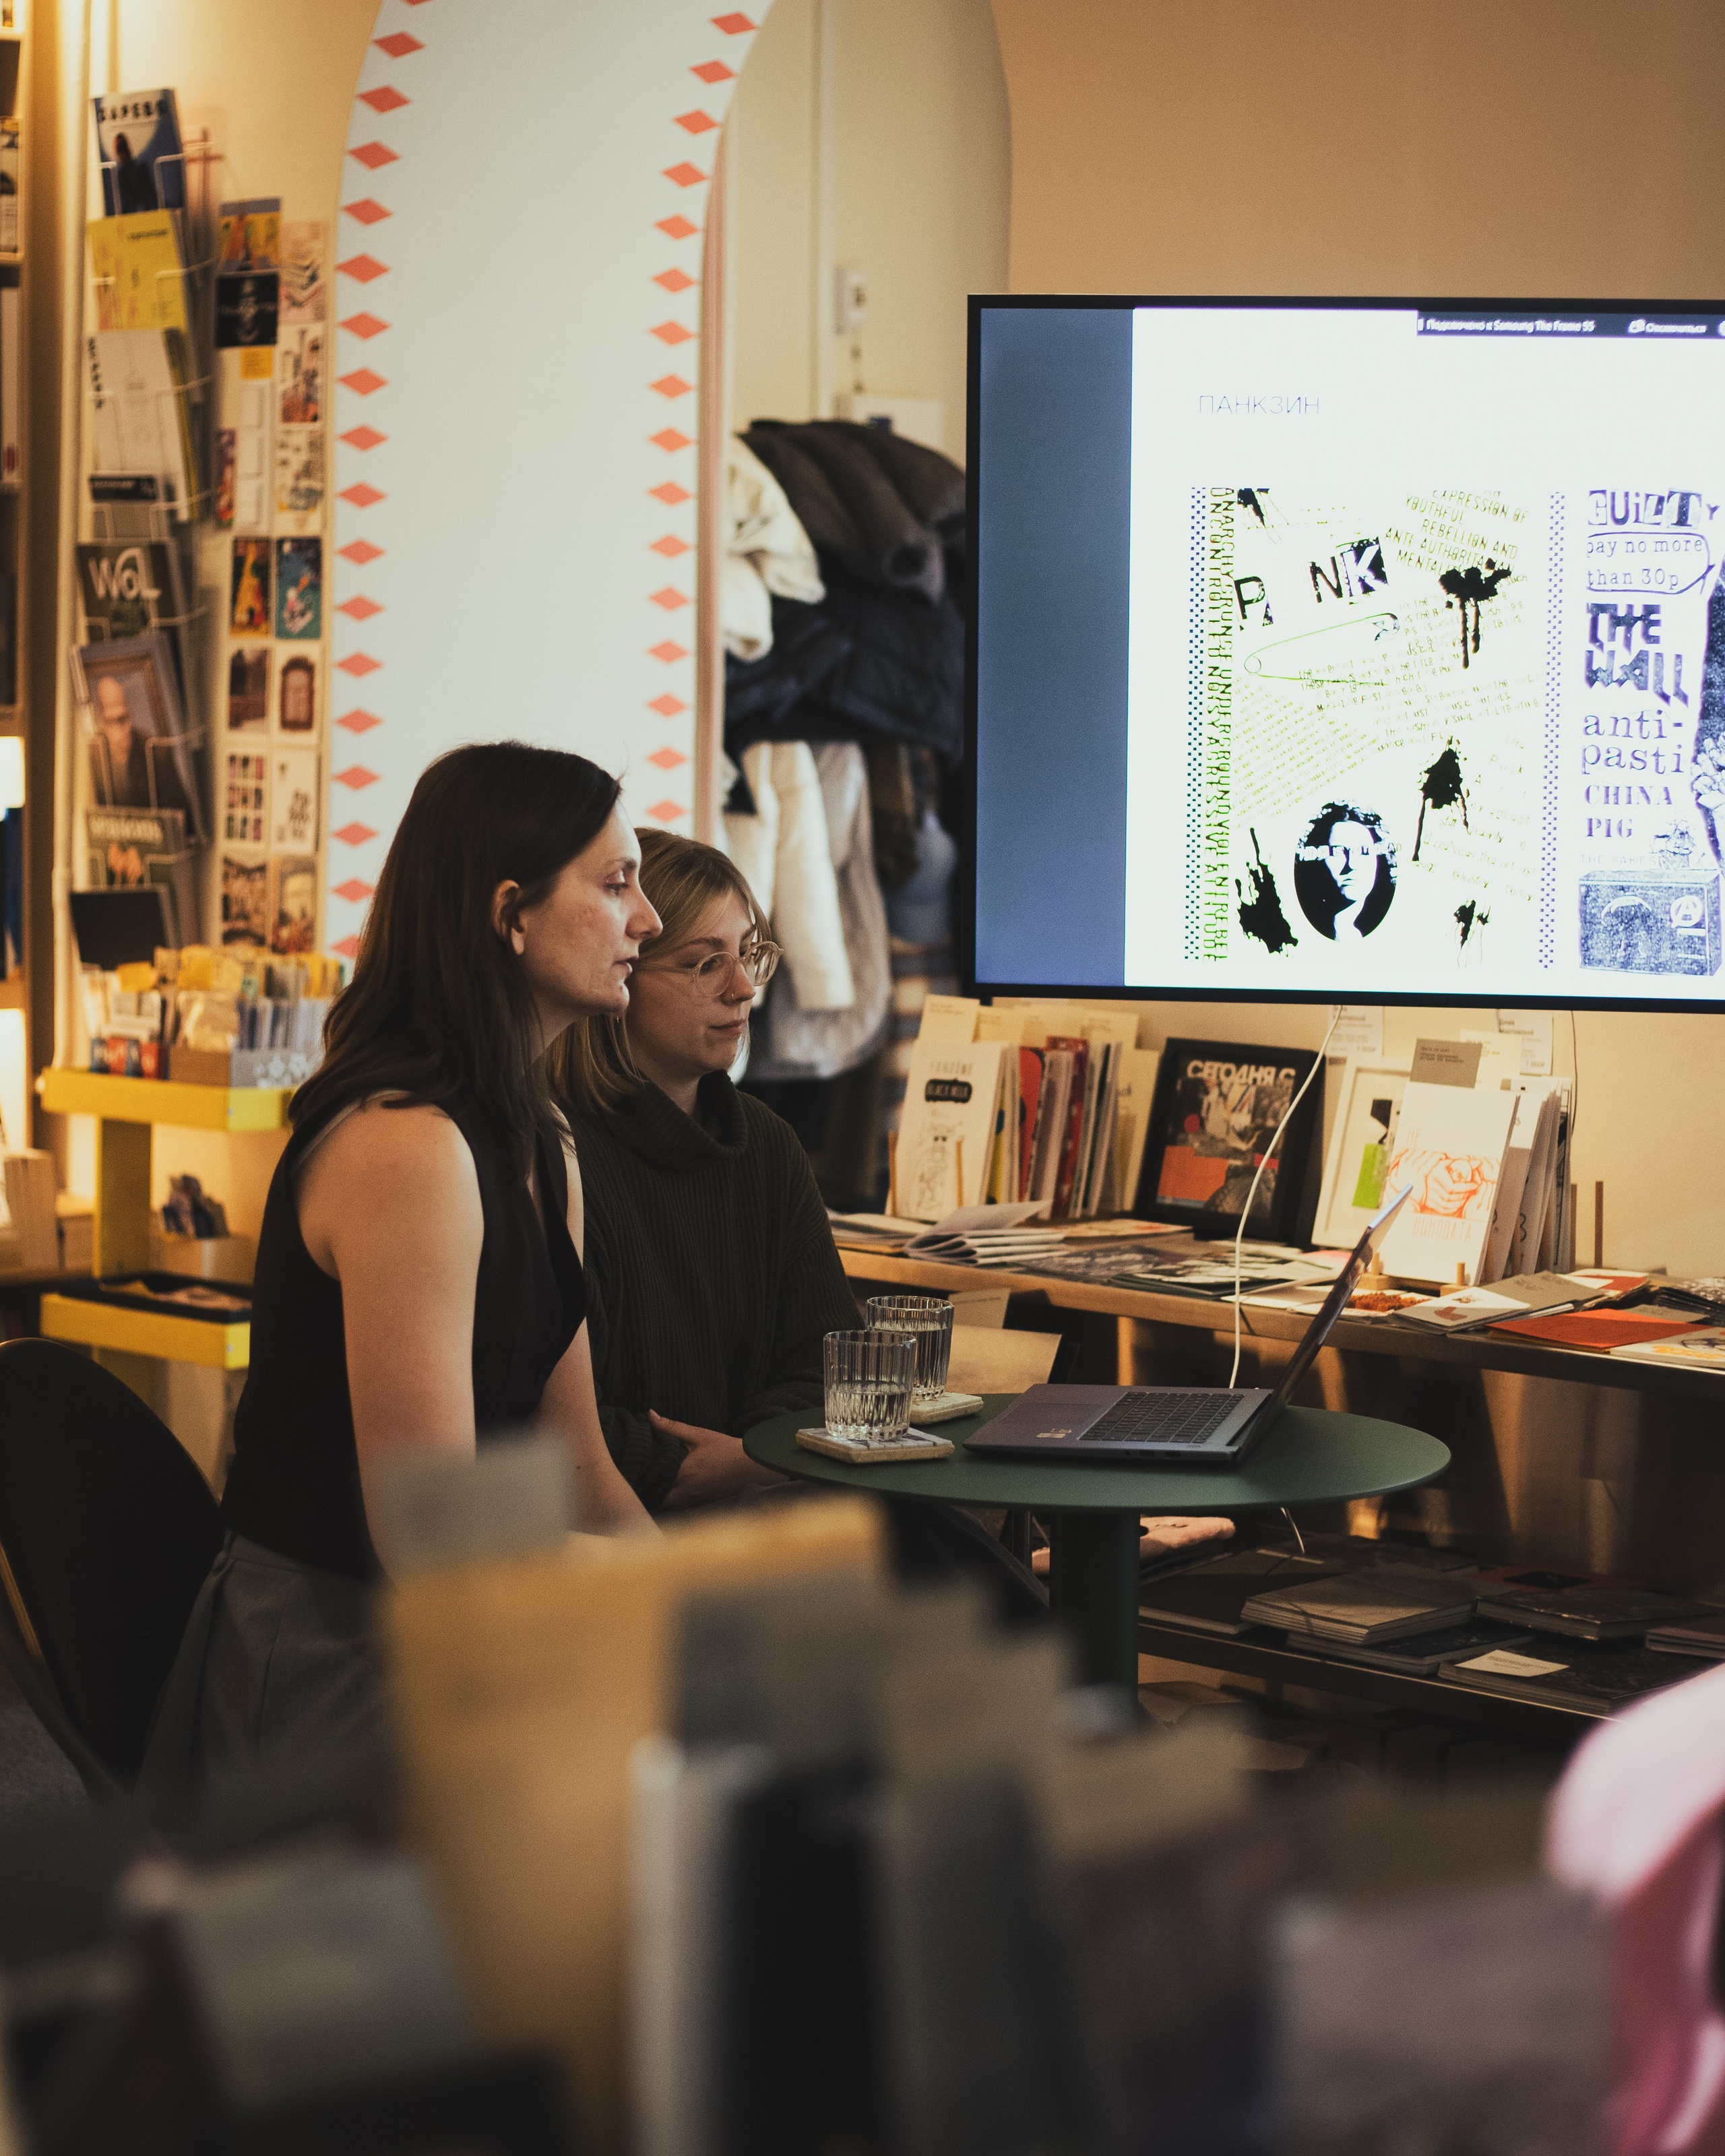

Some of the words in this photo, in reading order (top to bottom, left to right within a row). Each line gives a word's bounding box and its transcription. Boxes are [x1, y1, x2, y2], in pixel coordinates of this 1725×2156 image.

[1426, 319, 1485, 331] Подключено
[1494, 320, 1534, 333] Samsung
[1535, 320, 1552, 331] The
[1554, 321, 1580, 331] Frame
[1583, 321, 1594, 331] 55
[1645, 323, 1706, 334] Отключиться
[1199, 395, 1319, 414] ПАНКЗИН
[1406, 493, 1464, 525] YOUTHFUL
[1513, 509, 1529, 524] OF
[1220, 488, 1235, 581] ANARCHY
[1421, 519, 1488, 550] REBELLION
[1492, 541, 1518, 559] AND
[1587, 540, 1617, 558] pay
[1625, 540, 1647, 552] no
[1654, 539, 1702, 552] more
[1385, 528, 1414, 547] ANTI
[1420, 538, 1515, 571] AUTHORITAIAN
[1588, 569, 1633, 586] than
[1641, 569, 1679, 590] 30p
[1220, 583, 1233, 663] GRUNGE
[1586, 602, 1662, 656] THE
[1583, 709, 1683, 739] anti-
[1217, 670, 1232, 814] UNDERGROUND
[1581, 744, 1684, 775] pasti
[1584, 785, 1672, 804] CHINA
[1586, 818, 1633, 837] PIG
[1581, 855, 1604, 864] THE
[1214, 903, 1228, 961] REBEL
[1187, 1060, 1276, 1086] СЕГОДНЯ
